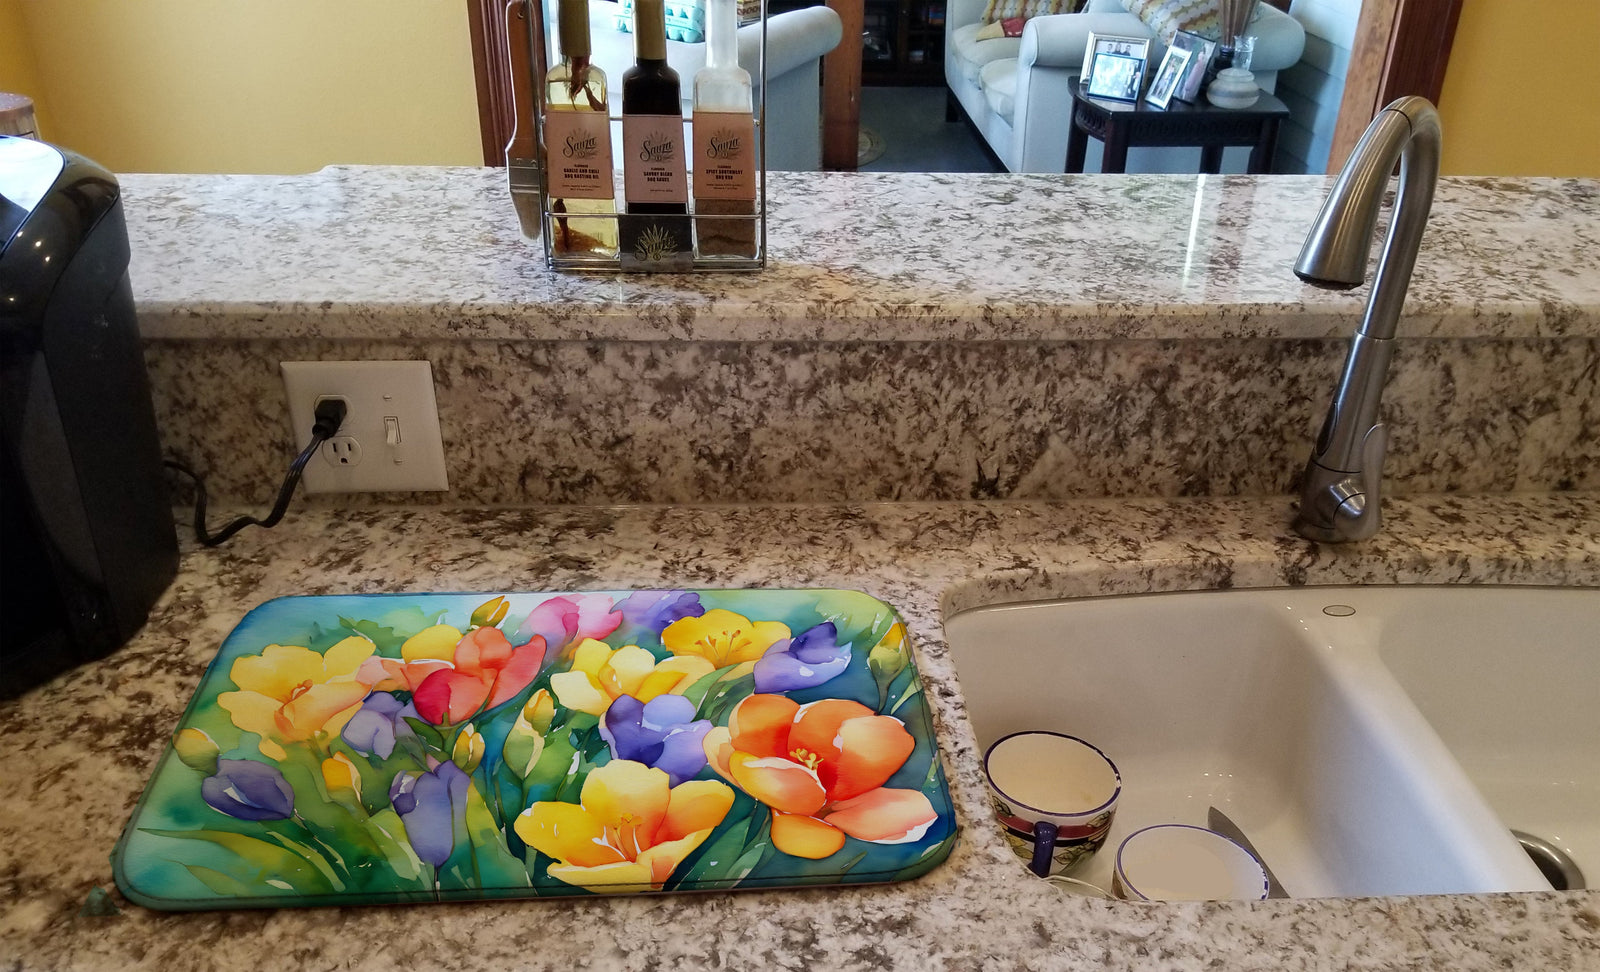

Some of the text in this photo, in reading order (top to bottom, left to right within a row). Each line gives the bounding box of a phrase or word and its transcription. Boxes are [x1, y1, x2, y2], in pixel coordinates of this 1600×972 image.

[563, 136, 598, 158] Sauza
[640, 140, 674, 161] Sauza
[707, 137, 740, 158] Sauza
